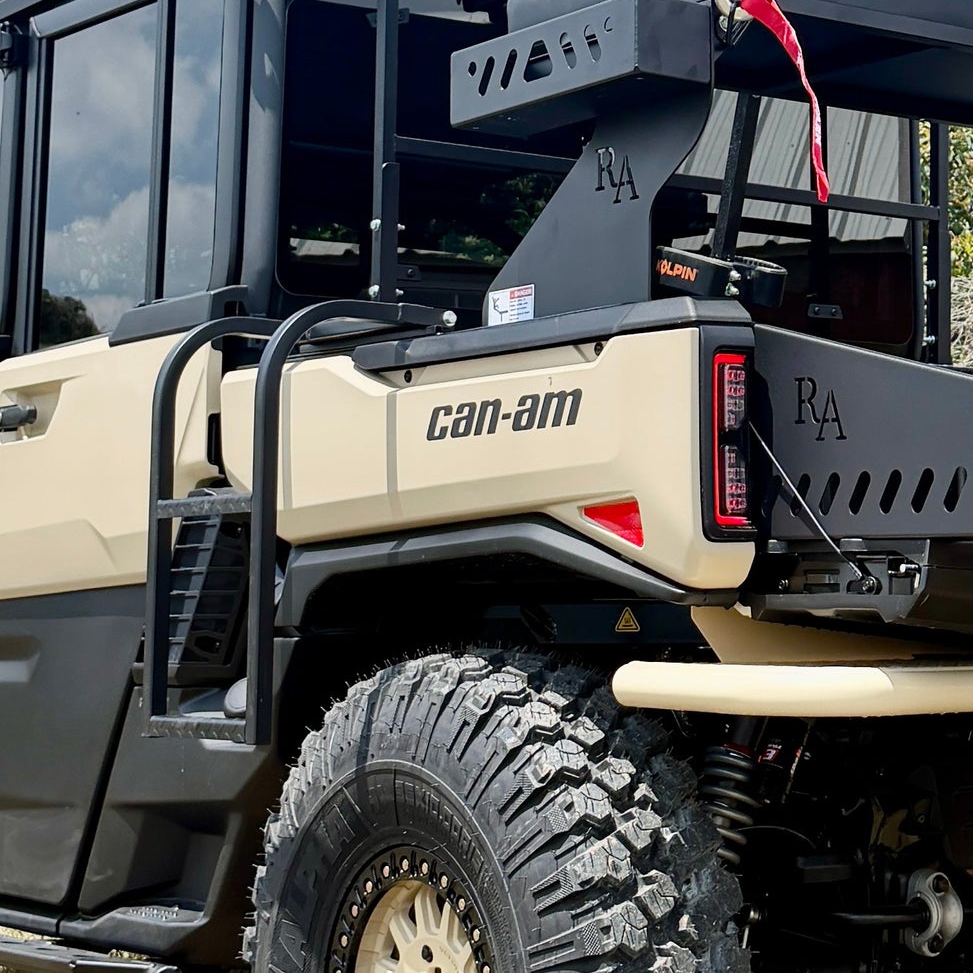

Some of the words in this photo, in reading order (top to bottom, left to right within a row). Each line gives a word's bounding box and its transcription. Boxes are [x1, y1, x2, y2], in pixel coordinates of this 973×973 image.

[595, 146, 639, 204] RA
[656, 259, 698, 282] KOLPIN
[426, 388, 583, 441] can-am
[794, 376, 847, 441] RA
